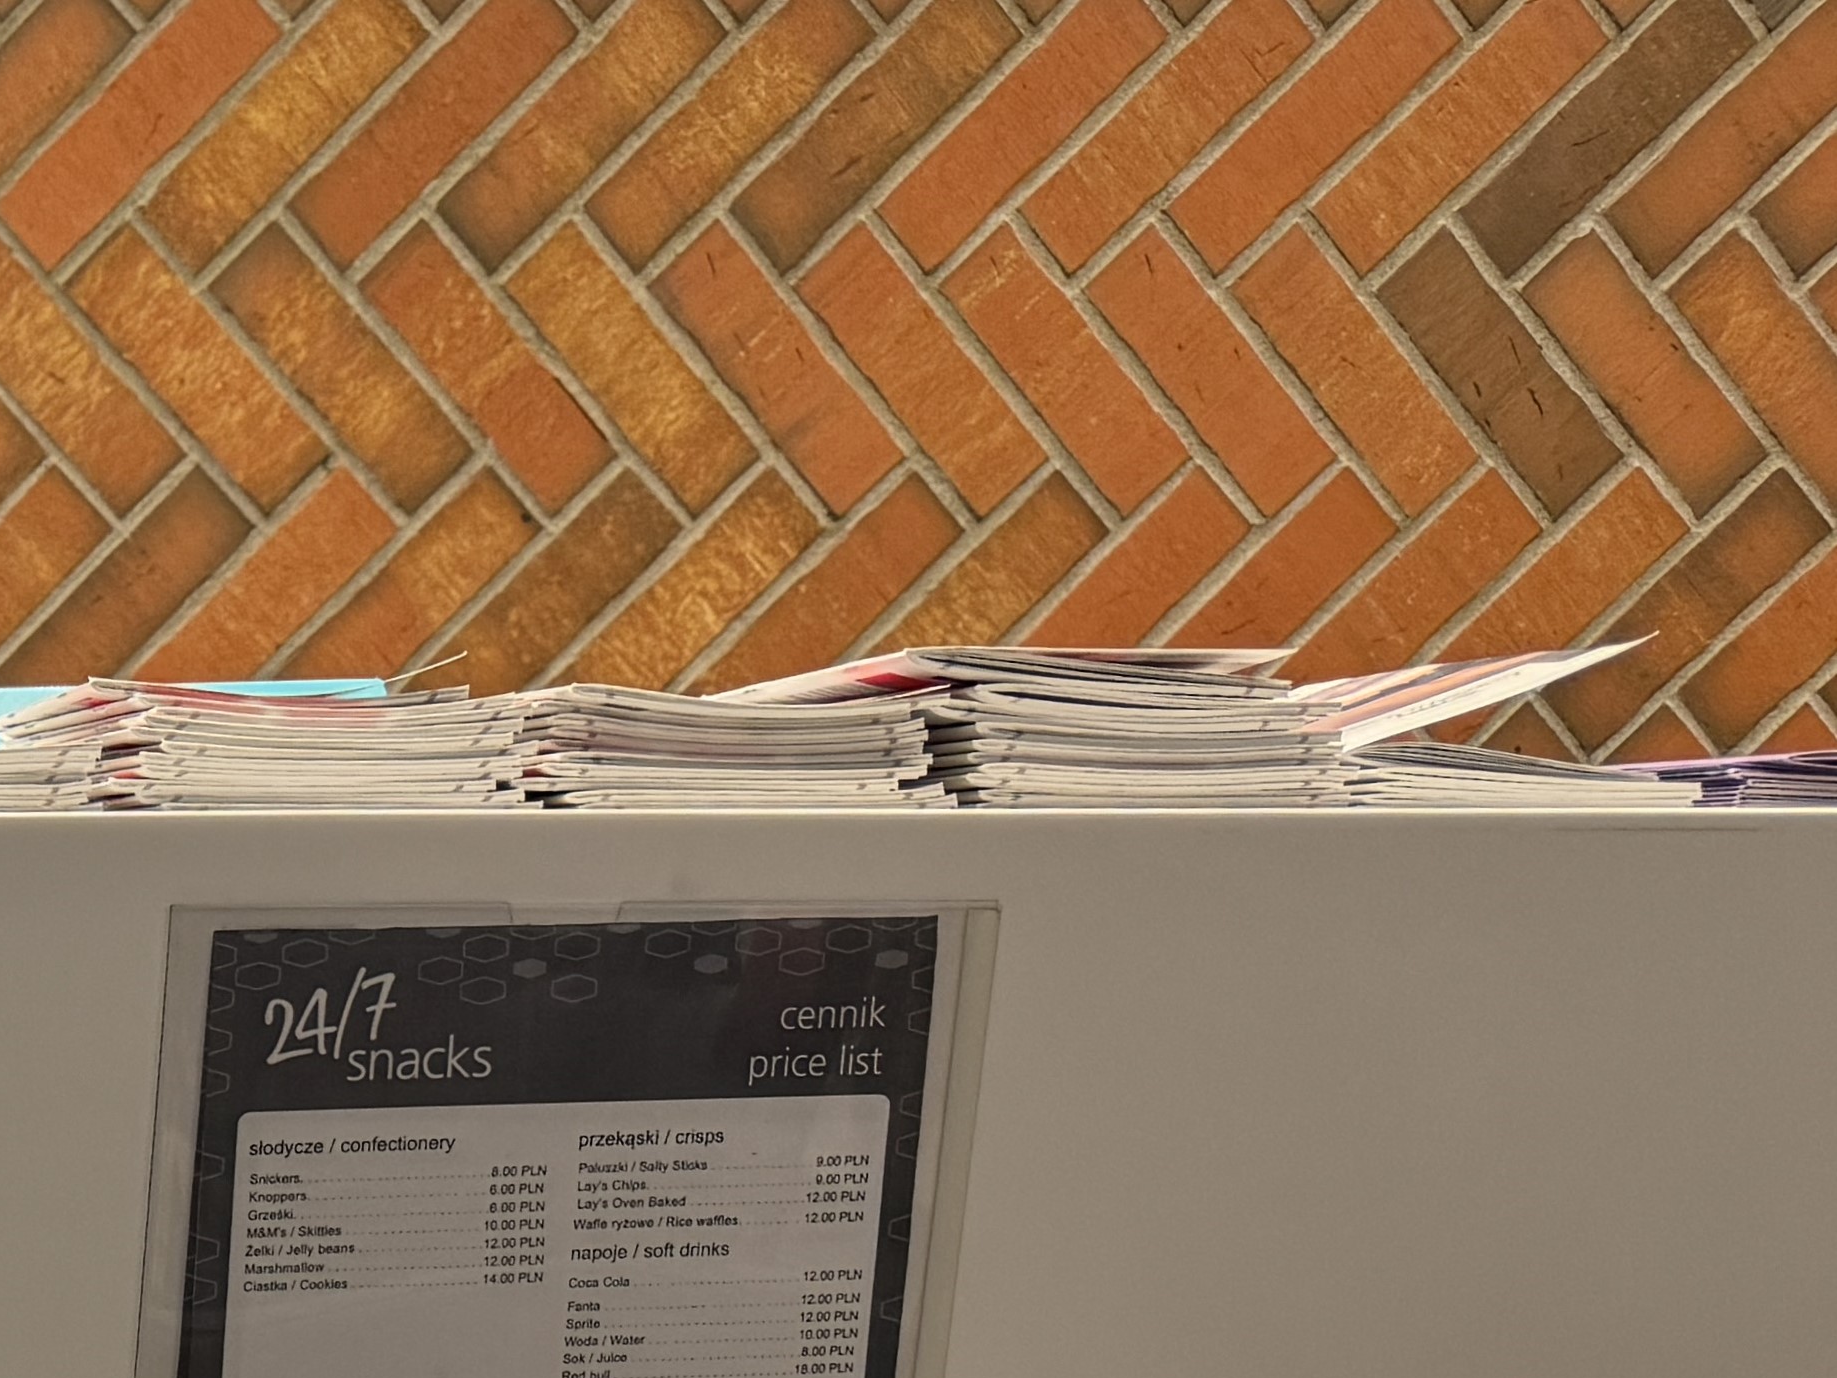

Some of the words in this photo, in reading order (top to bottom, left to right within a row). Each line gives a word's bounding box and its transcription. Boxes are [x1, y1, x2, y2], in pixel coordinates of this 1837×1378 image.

[263, 967, 398, 1065] 24/7
[779, 996, 886, 1031] cennik
[346, 1033, 494, 1082] snacks
[747, 1047, 827, 1087] price
[838, 1044, 883, 1079] list
[248, 1139, 324, 1158] słodycze
[340, 1136, 456, 1154] confectionery
[578, 1130, 660, 1151] przekąski
[675, 1128, 725, 1146] crisps
[844, 1155, 870, 1167] PLN
[522, 1165, 547, 1177] PLN
[844, 1173, 869, 1184] PLN
[519, 1183, 544, 1195] PLN
[519, 1201, 545, 1212] PLN
[612, 1197, 645, 1209] Oven
[648, 1196, 686, 1208] Baked
[806, 1192, 838, 1203] 12.00
[841, 1191, 866, 1202] PLN
[484, 1219, 516, 1231] 10.00
[519, 1219, 545, 1230] PLN
[805, 1212, 837, 1224] 12.00
[839, 1211, 864, 1223] PLN
[318, 1243, 355, 1254] beans
[484, 1237, 516, 1249] 12.00
[519, 1237, 545, 1248] PLN
[571, 1244, 628, 1263] napoje
[643, 1243, 675, 1259] soft
[679, 1242, 730, 1258] drinks
[244, 1262, 325, 1275] Marshmallow
[483, 1255, 516, 1267] 12.00
[518, 1254, 545, 1266] PLN
[243, 1280, 288, 1292] Ciastka
[300, 1278, 348, 1291] Cookies
[483, 1273, 515, 1285] 14.00
[518, 1272, 543, 1284] PLN
[568, 1277, 599, 1289] Coca
[603, 1276, 630, 1288] Cola
[803, 1270, 835, 1282] 12.00
[837, 1269, 863, 1281] PLN
[567, 1301, 600, 1312] Fanta
[801, 1294, 833, 1305] 12.00
[836, 1293, 861, 1304] PLN
[800, 1312, 831, 1323] 12.00
[833, 1310, 859, 1322] PLN
[564, 1335, 599, 1347] Woda
[610, 1334, 645, 1346] Water
[833, 1328, 859, 1339] PLN
[562, 1353, 585, 1364] Sok
[829, 1345, 854, 1356] PLN
[828, 1362, 854, 1374] PLN
